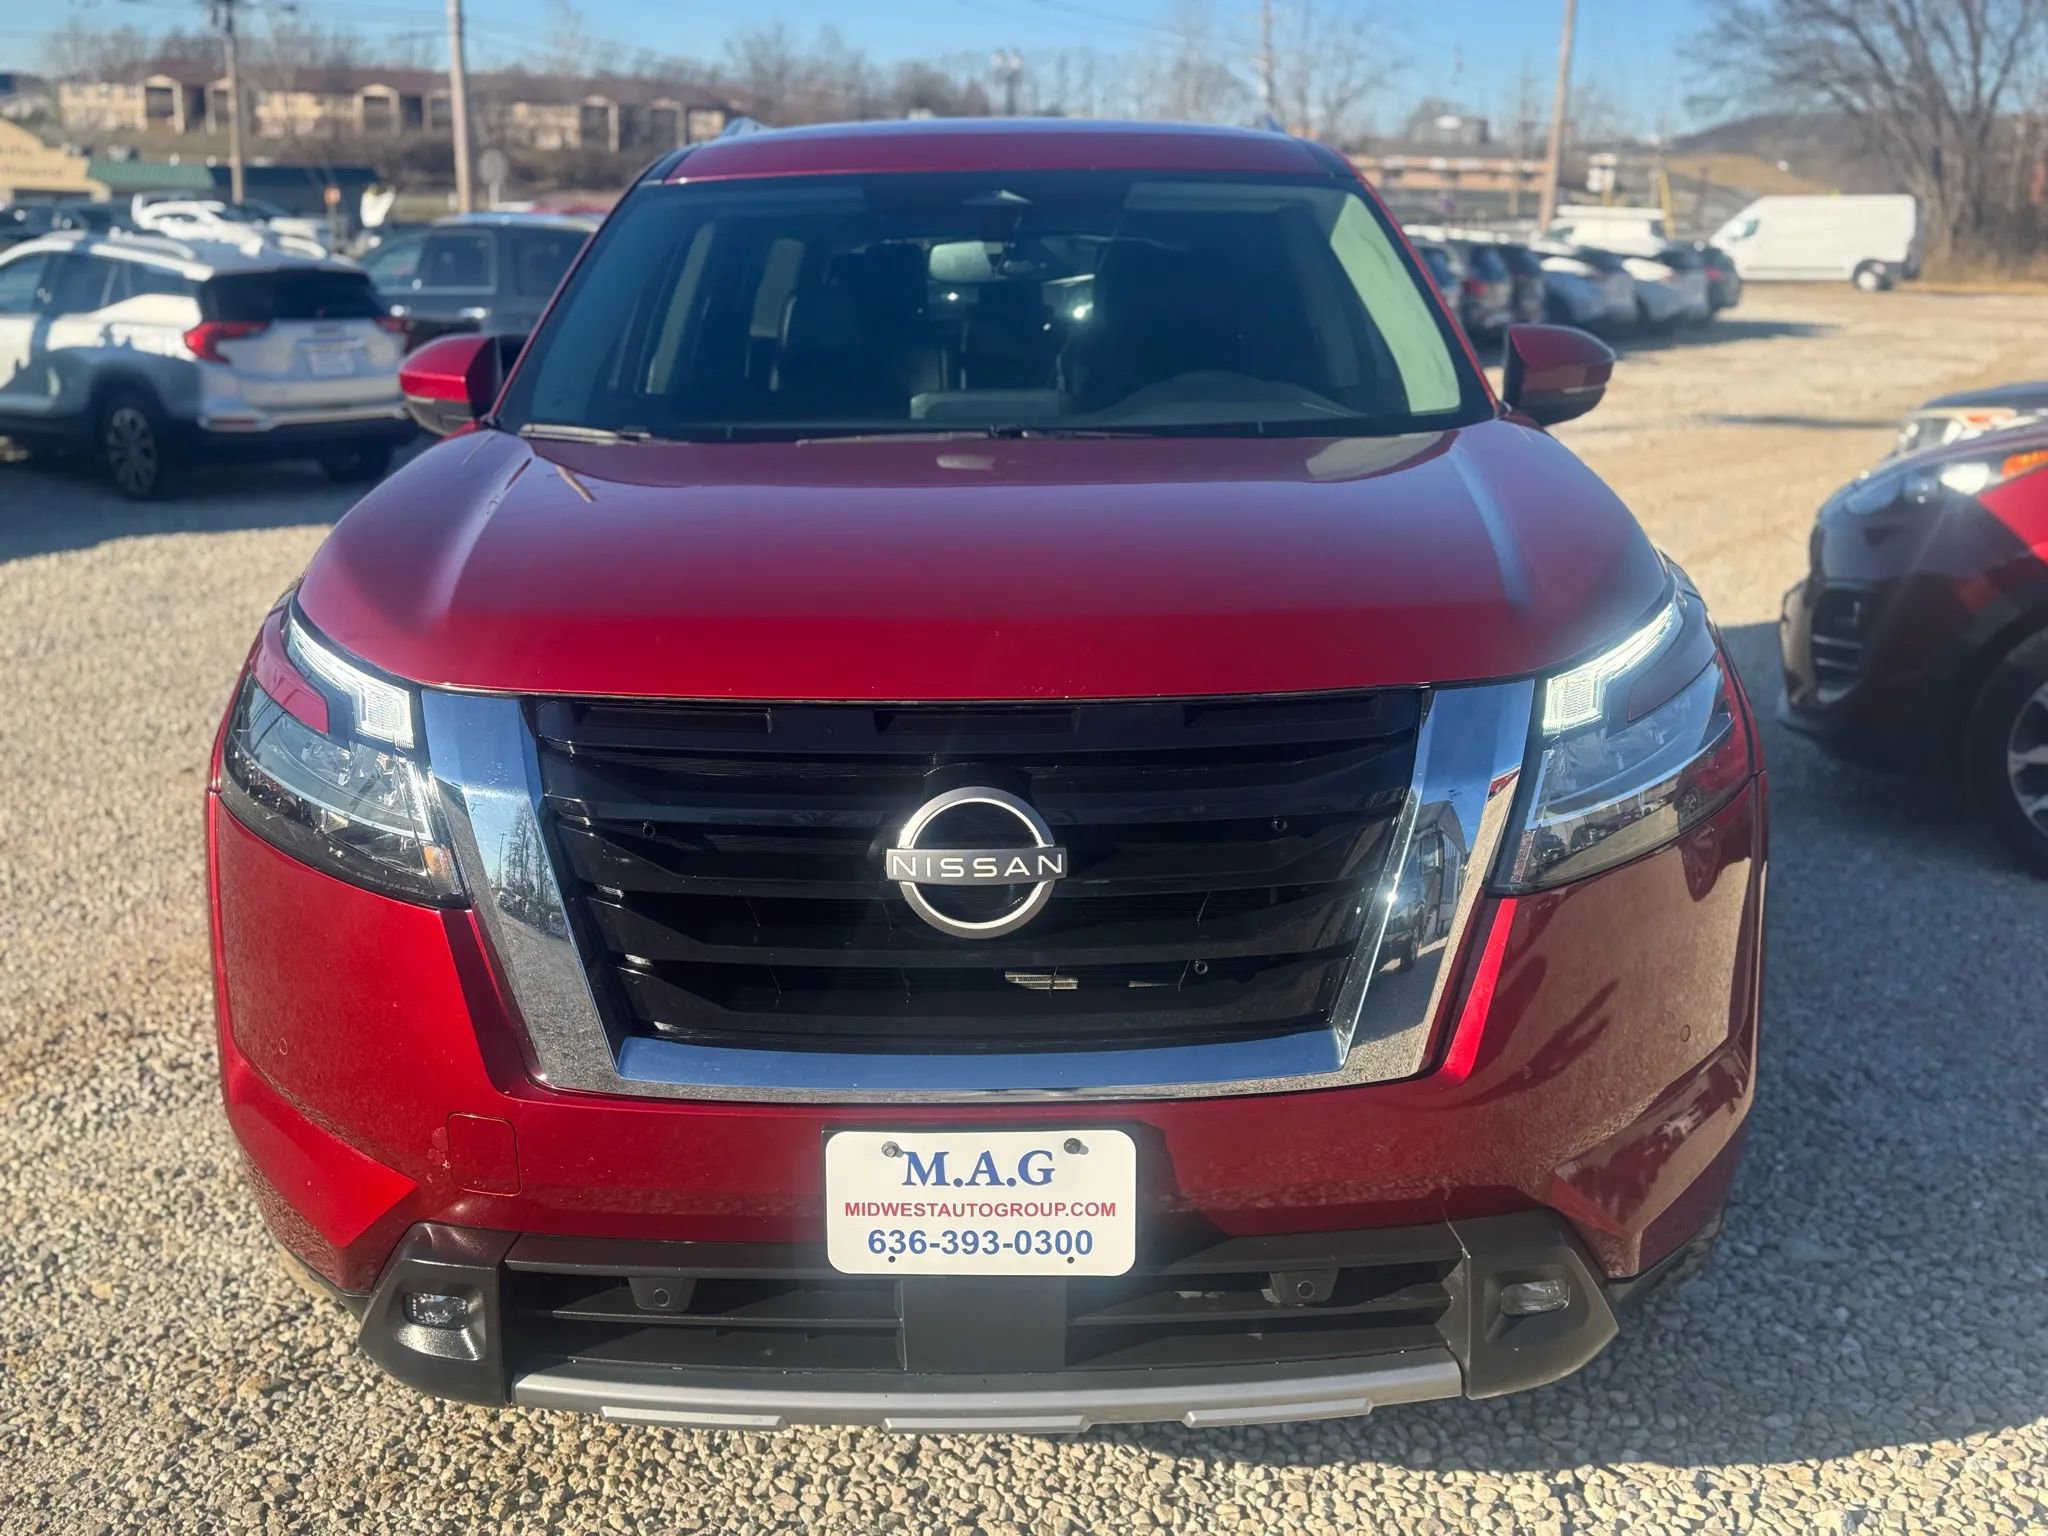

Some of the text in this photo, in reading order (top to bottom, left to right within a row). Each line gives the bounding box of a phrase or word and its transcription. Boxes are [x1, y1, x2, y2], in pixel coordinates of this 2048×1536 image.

[892, 853, 1062, 878] NISSAN
[901, 1149, 1056, 1188] M.A.G
[844, 1201, 1117, 1218] MIDWESTAUTOGROUP.COM
[867, 1228, 1094, 1256] 636-393-0300
